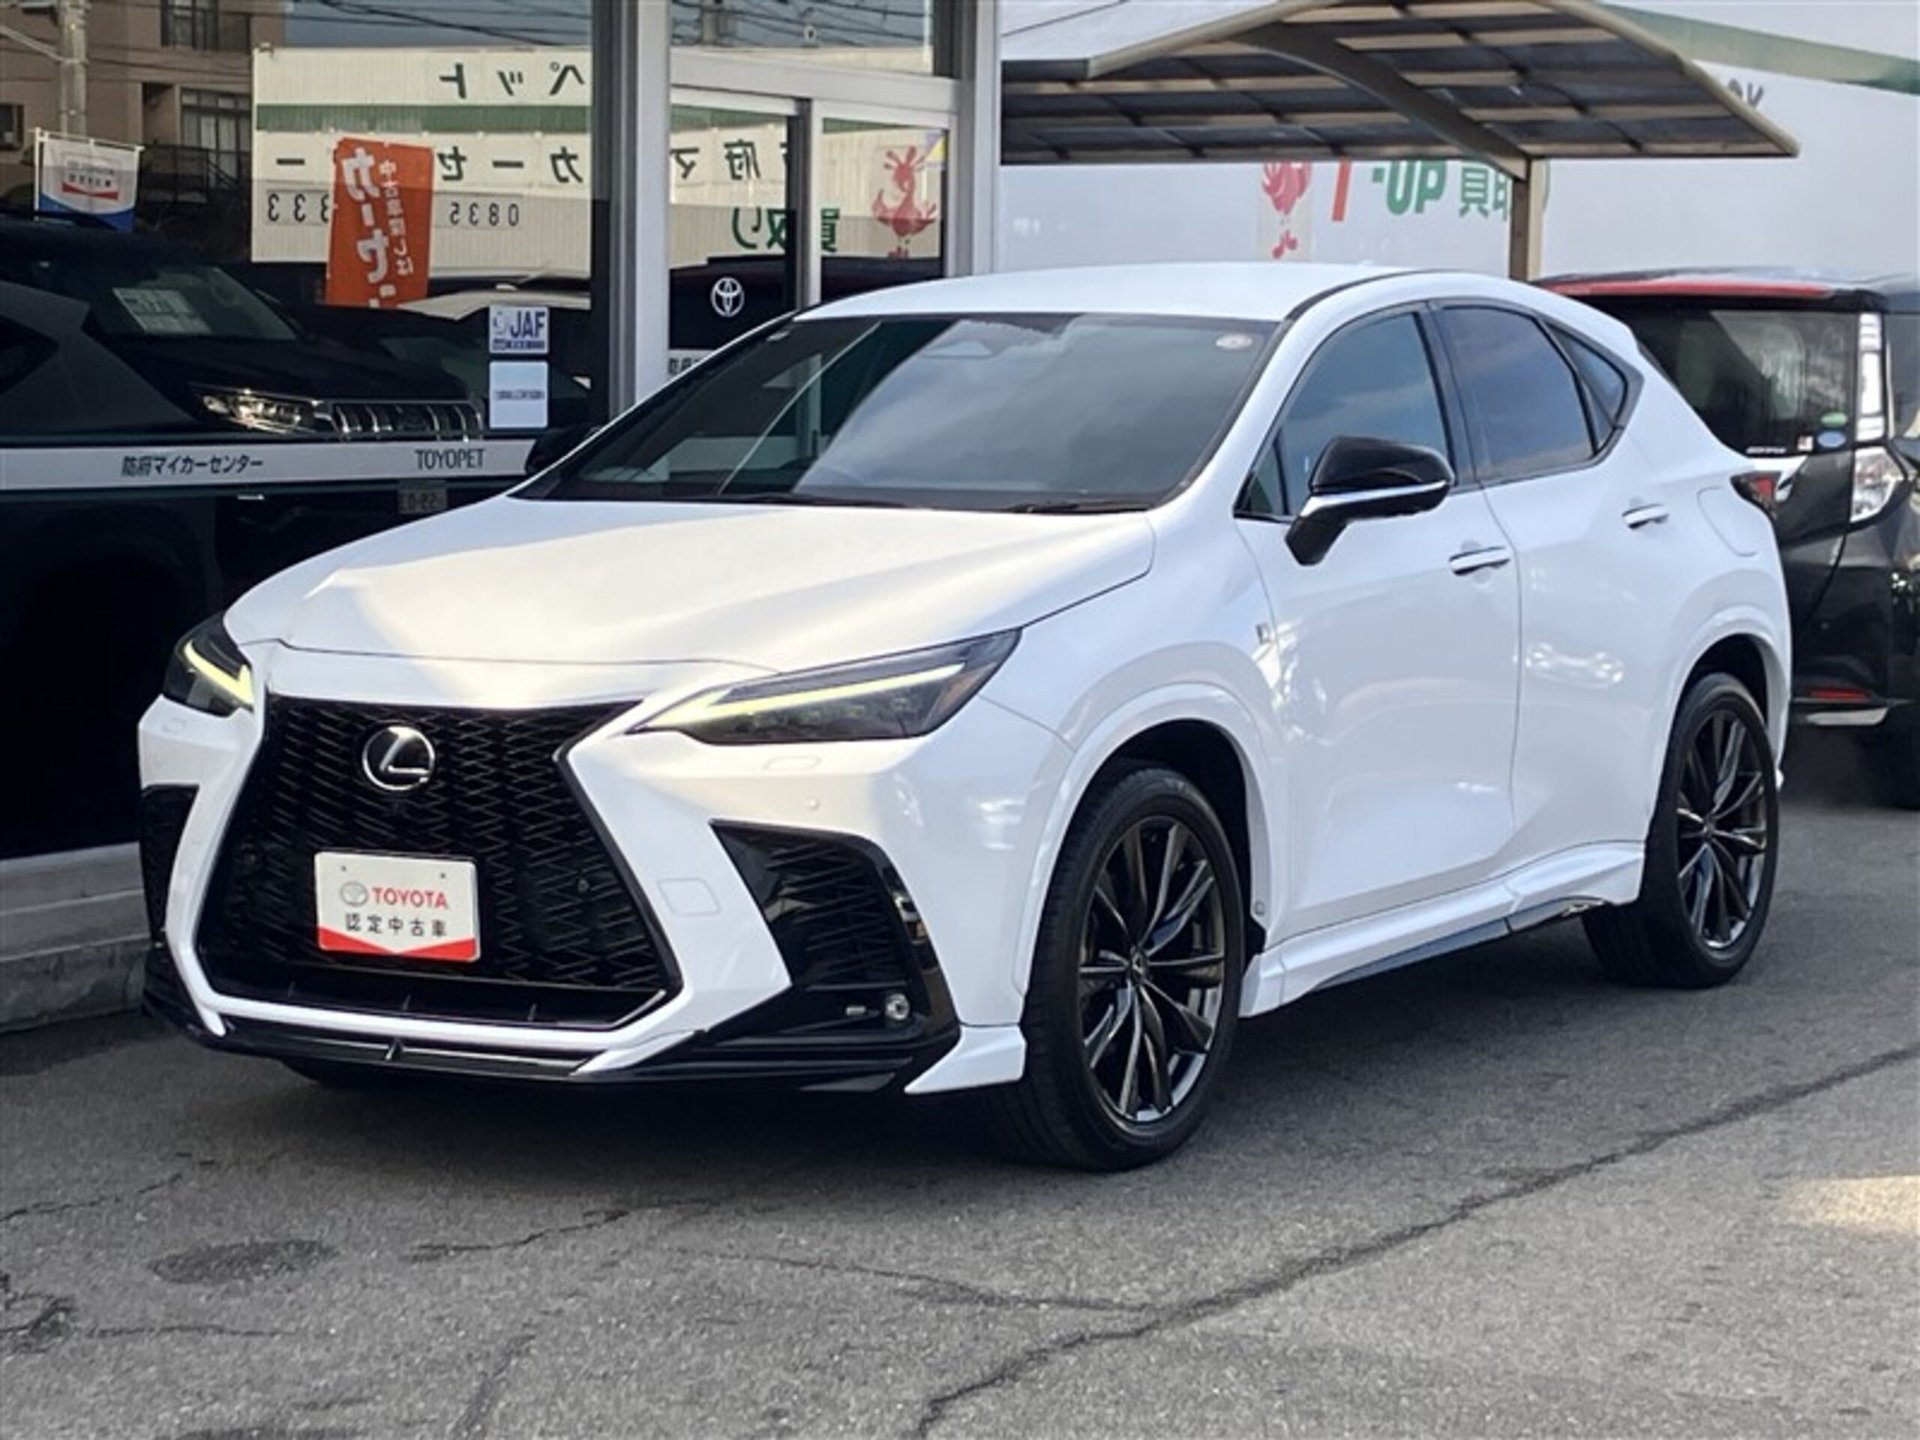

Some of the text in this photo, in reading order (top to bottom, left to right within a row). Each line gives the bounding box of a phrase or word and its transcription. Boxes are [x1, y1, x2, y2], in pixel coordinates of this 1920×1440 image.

[510, 311, 546, 338] JAF
[121, 455, 263, 477] 防府マイカーセンター
[415, 448, 485, 470] TOYOPET
[372, 887, 448, 909] TOYOTA
[345, 913, 448, 938] 認定中古車
